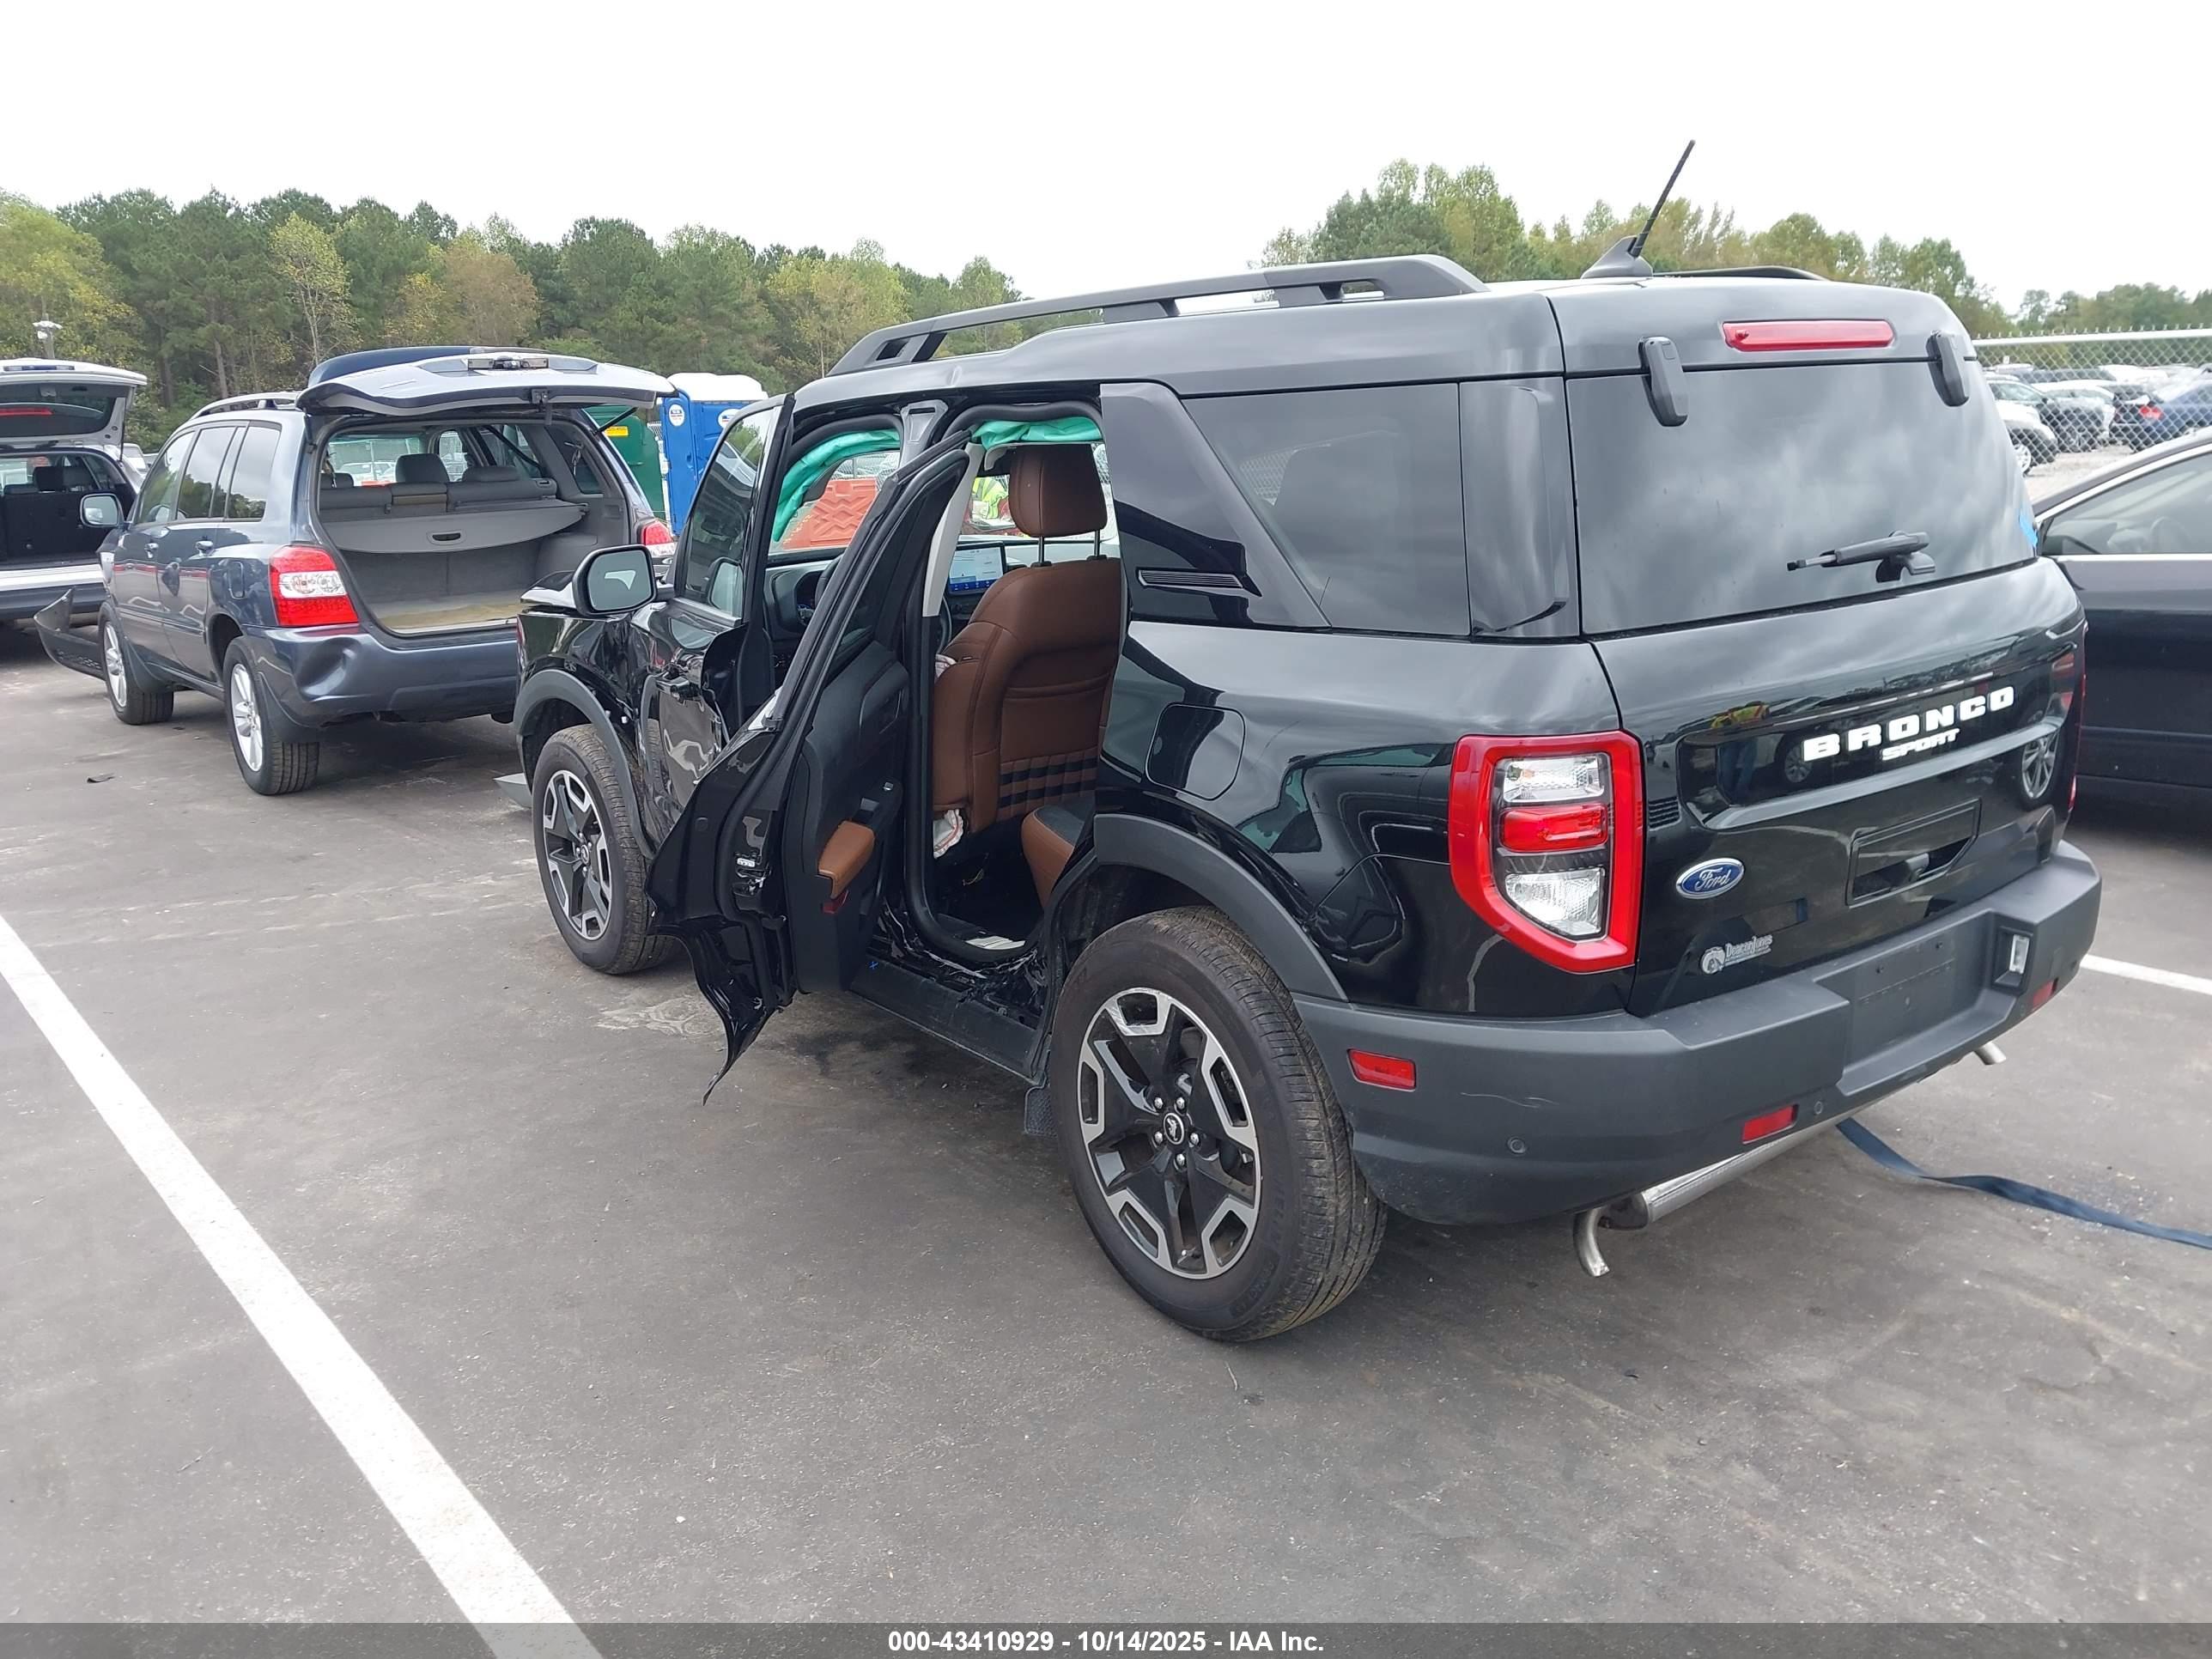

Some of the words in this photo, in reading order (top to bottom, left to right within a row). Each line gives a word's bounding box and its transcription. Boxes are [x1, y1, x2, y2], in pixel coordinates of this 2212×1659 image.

[1802, 686, 2014, 762] BRONCO
[1881, 728, 1960, 761] SPORT
[1694, 866, 1732, 891] Ford
